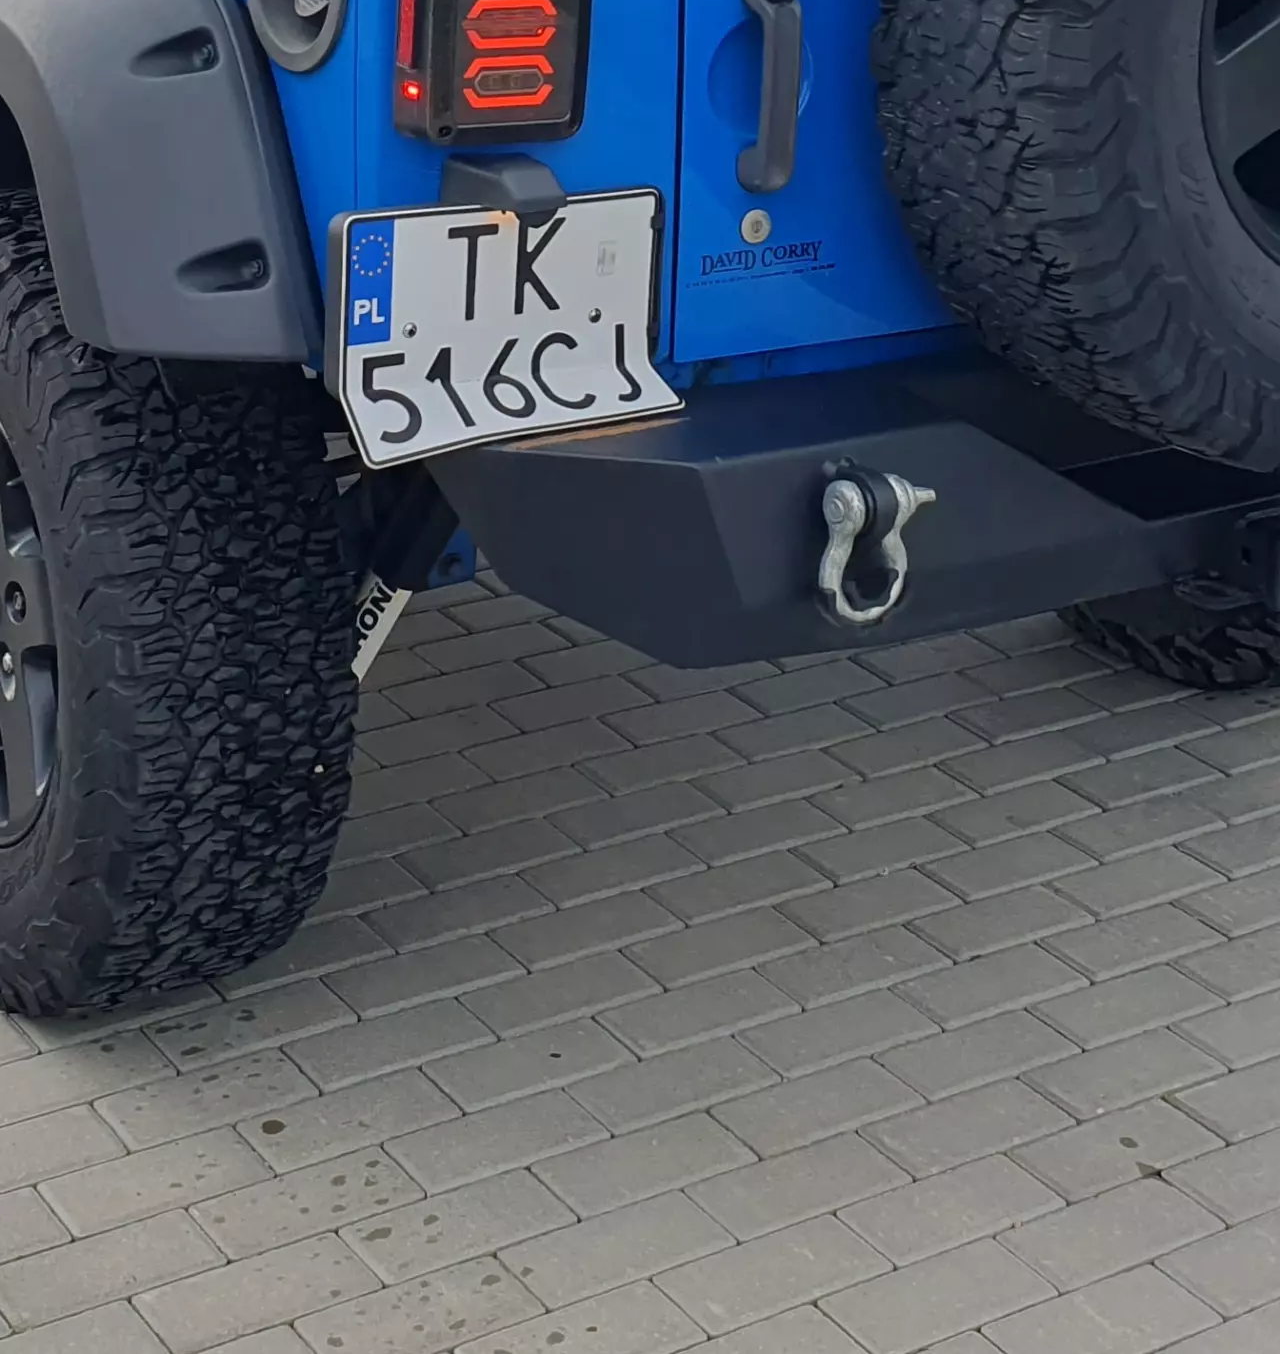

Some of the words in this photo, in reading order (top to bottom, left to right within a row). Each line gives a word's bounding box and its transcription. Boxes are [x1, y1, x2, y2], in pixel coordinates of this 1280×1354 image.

[448, 217, 567, 321] TK
[701, 249, 757, 277] DAVID
[761, 240, 823, 268] CORRY
[353, 297, 385, 327] PL
[361, 324, 642, 443] 516CJ
